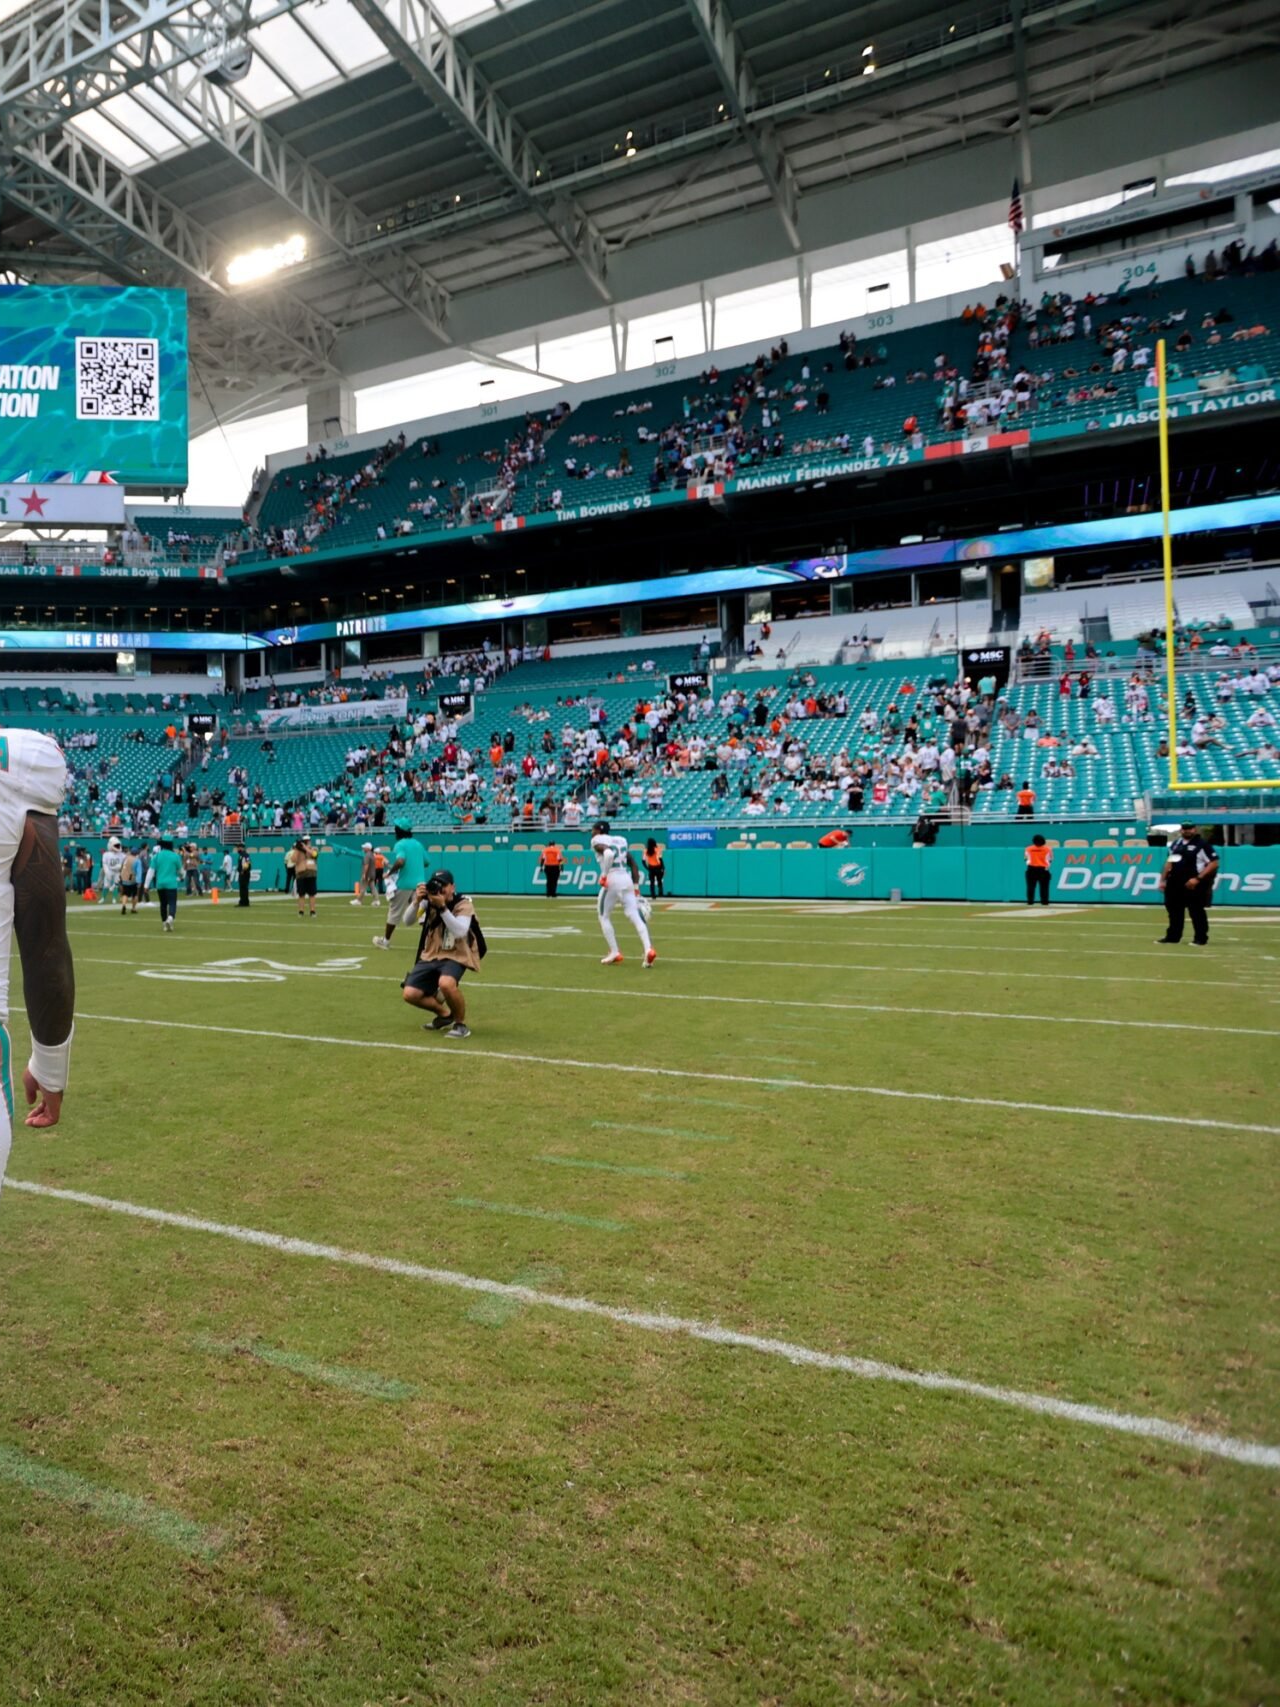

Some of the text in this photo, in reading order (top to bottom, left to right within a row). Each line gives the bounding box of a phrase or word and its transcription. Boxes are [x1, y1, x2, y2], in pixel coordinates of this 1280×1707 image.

[1122, 262, 1156, 281] 304
[868, 314, 894, 330] 303
[655, 365, 676, 378] 302
[481, 406, 498, 418] 301
[1108, 389, 1277, 429] JASON TAYLOR
[736, 453, 909, 491] MANNY FERNANDEZ 75
[556, 495, 652, 521] TIM BOWENS 95
[23, 566, 47, 575] 17-0
[100, 567, 129, 577] SUPER
[132, 567, 159, 577] BOWL
[336, 617, 387, 637] PATRIOTS
[65, 632, 150, 647] NEW ENGLAND
[980, 650, 1005, 659] MSC
[696, 832, 713, 841] NFL
[1065, 854, 1153, 865] MIAMI
[1057, 866, 1275, 896] Dolpns
